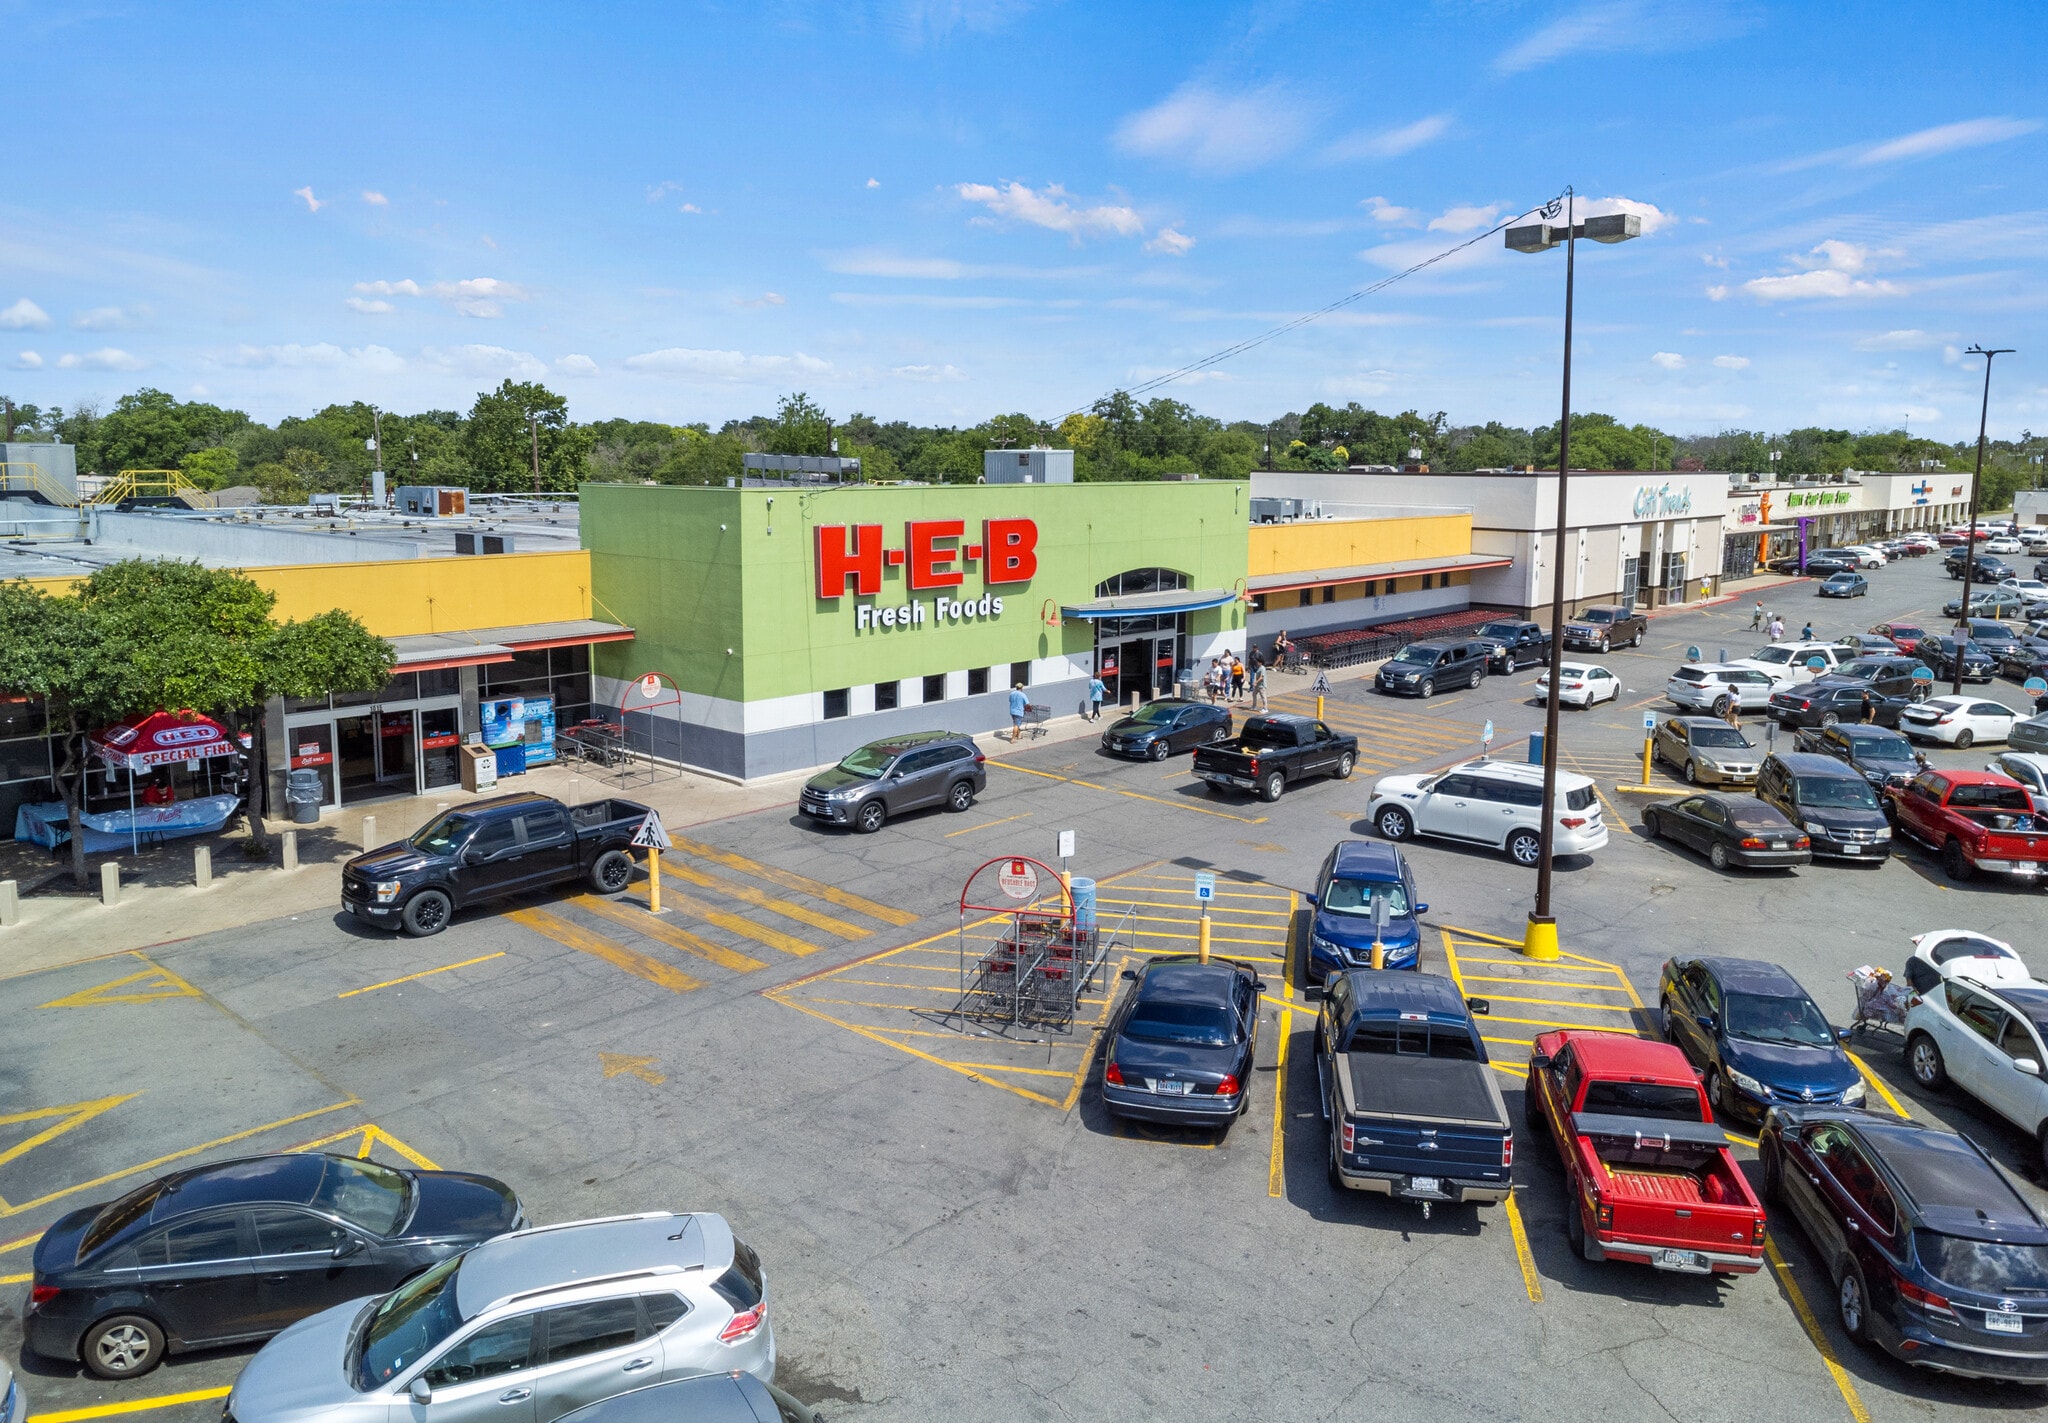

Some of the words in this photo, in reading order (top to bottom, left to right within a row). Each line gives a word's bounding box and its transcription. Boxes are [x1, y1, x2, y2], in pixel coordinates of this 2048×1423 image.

[814, 518, 1038, 598] H-E-B
[856, 599, 925, 629] Fresh
[936, 593, 1004, 621] Foods
[142, 748, 200, 765] SPECIAL
